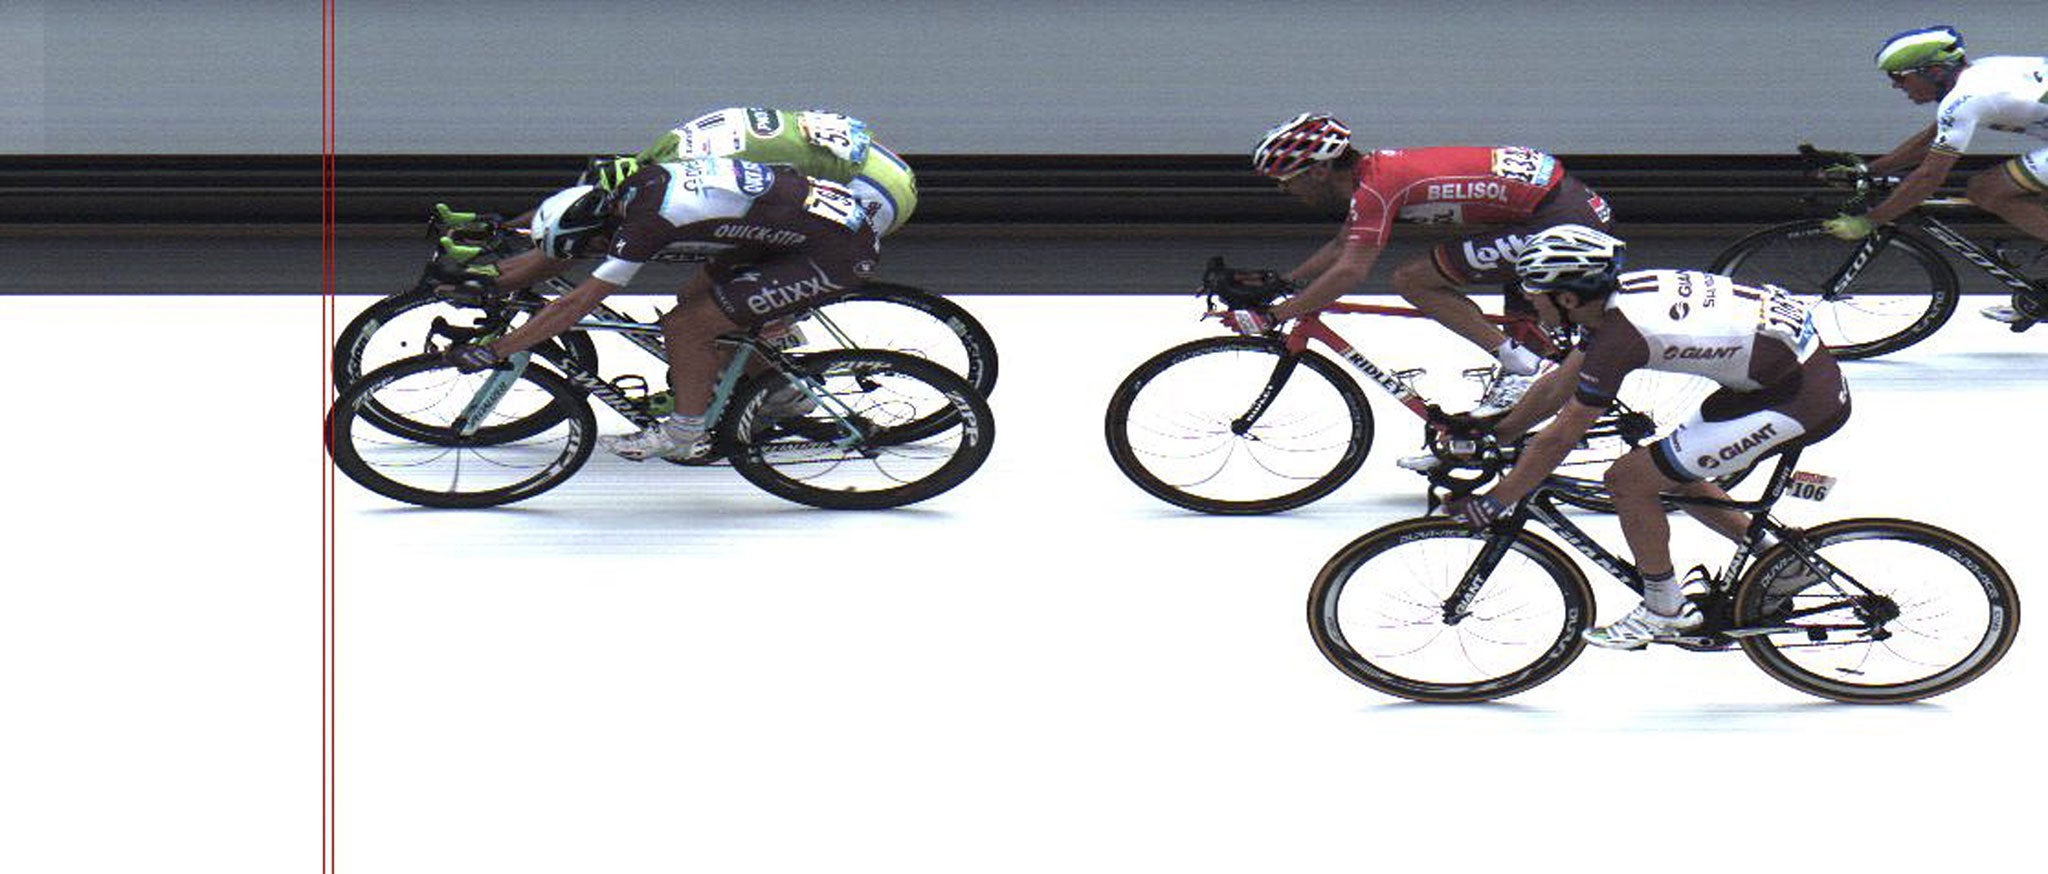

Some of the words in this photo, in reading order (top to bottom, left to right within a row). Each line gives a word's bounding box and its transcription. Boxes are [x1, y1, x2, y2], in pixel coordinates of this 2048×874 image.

[1427, 182, 1507, 201] BELISOL
[1680, 346, 1742, 360] GIANT
[1349, 351, 1405, 397] RIDLEY
[1719, 423, 1778, 461] GIANT
[1791, 482, 1827, 502] 106
[1455, 576, 1485, 616] GIANT
